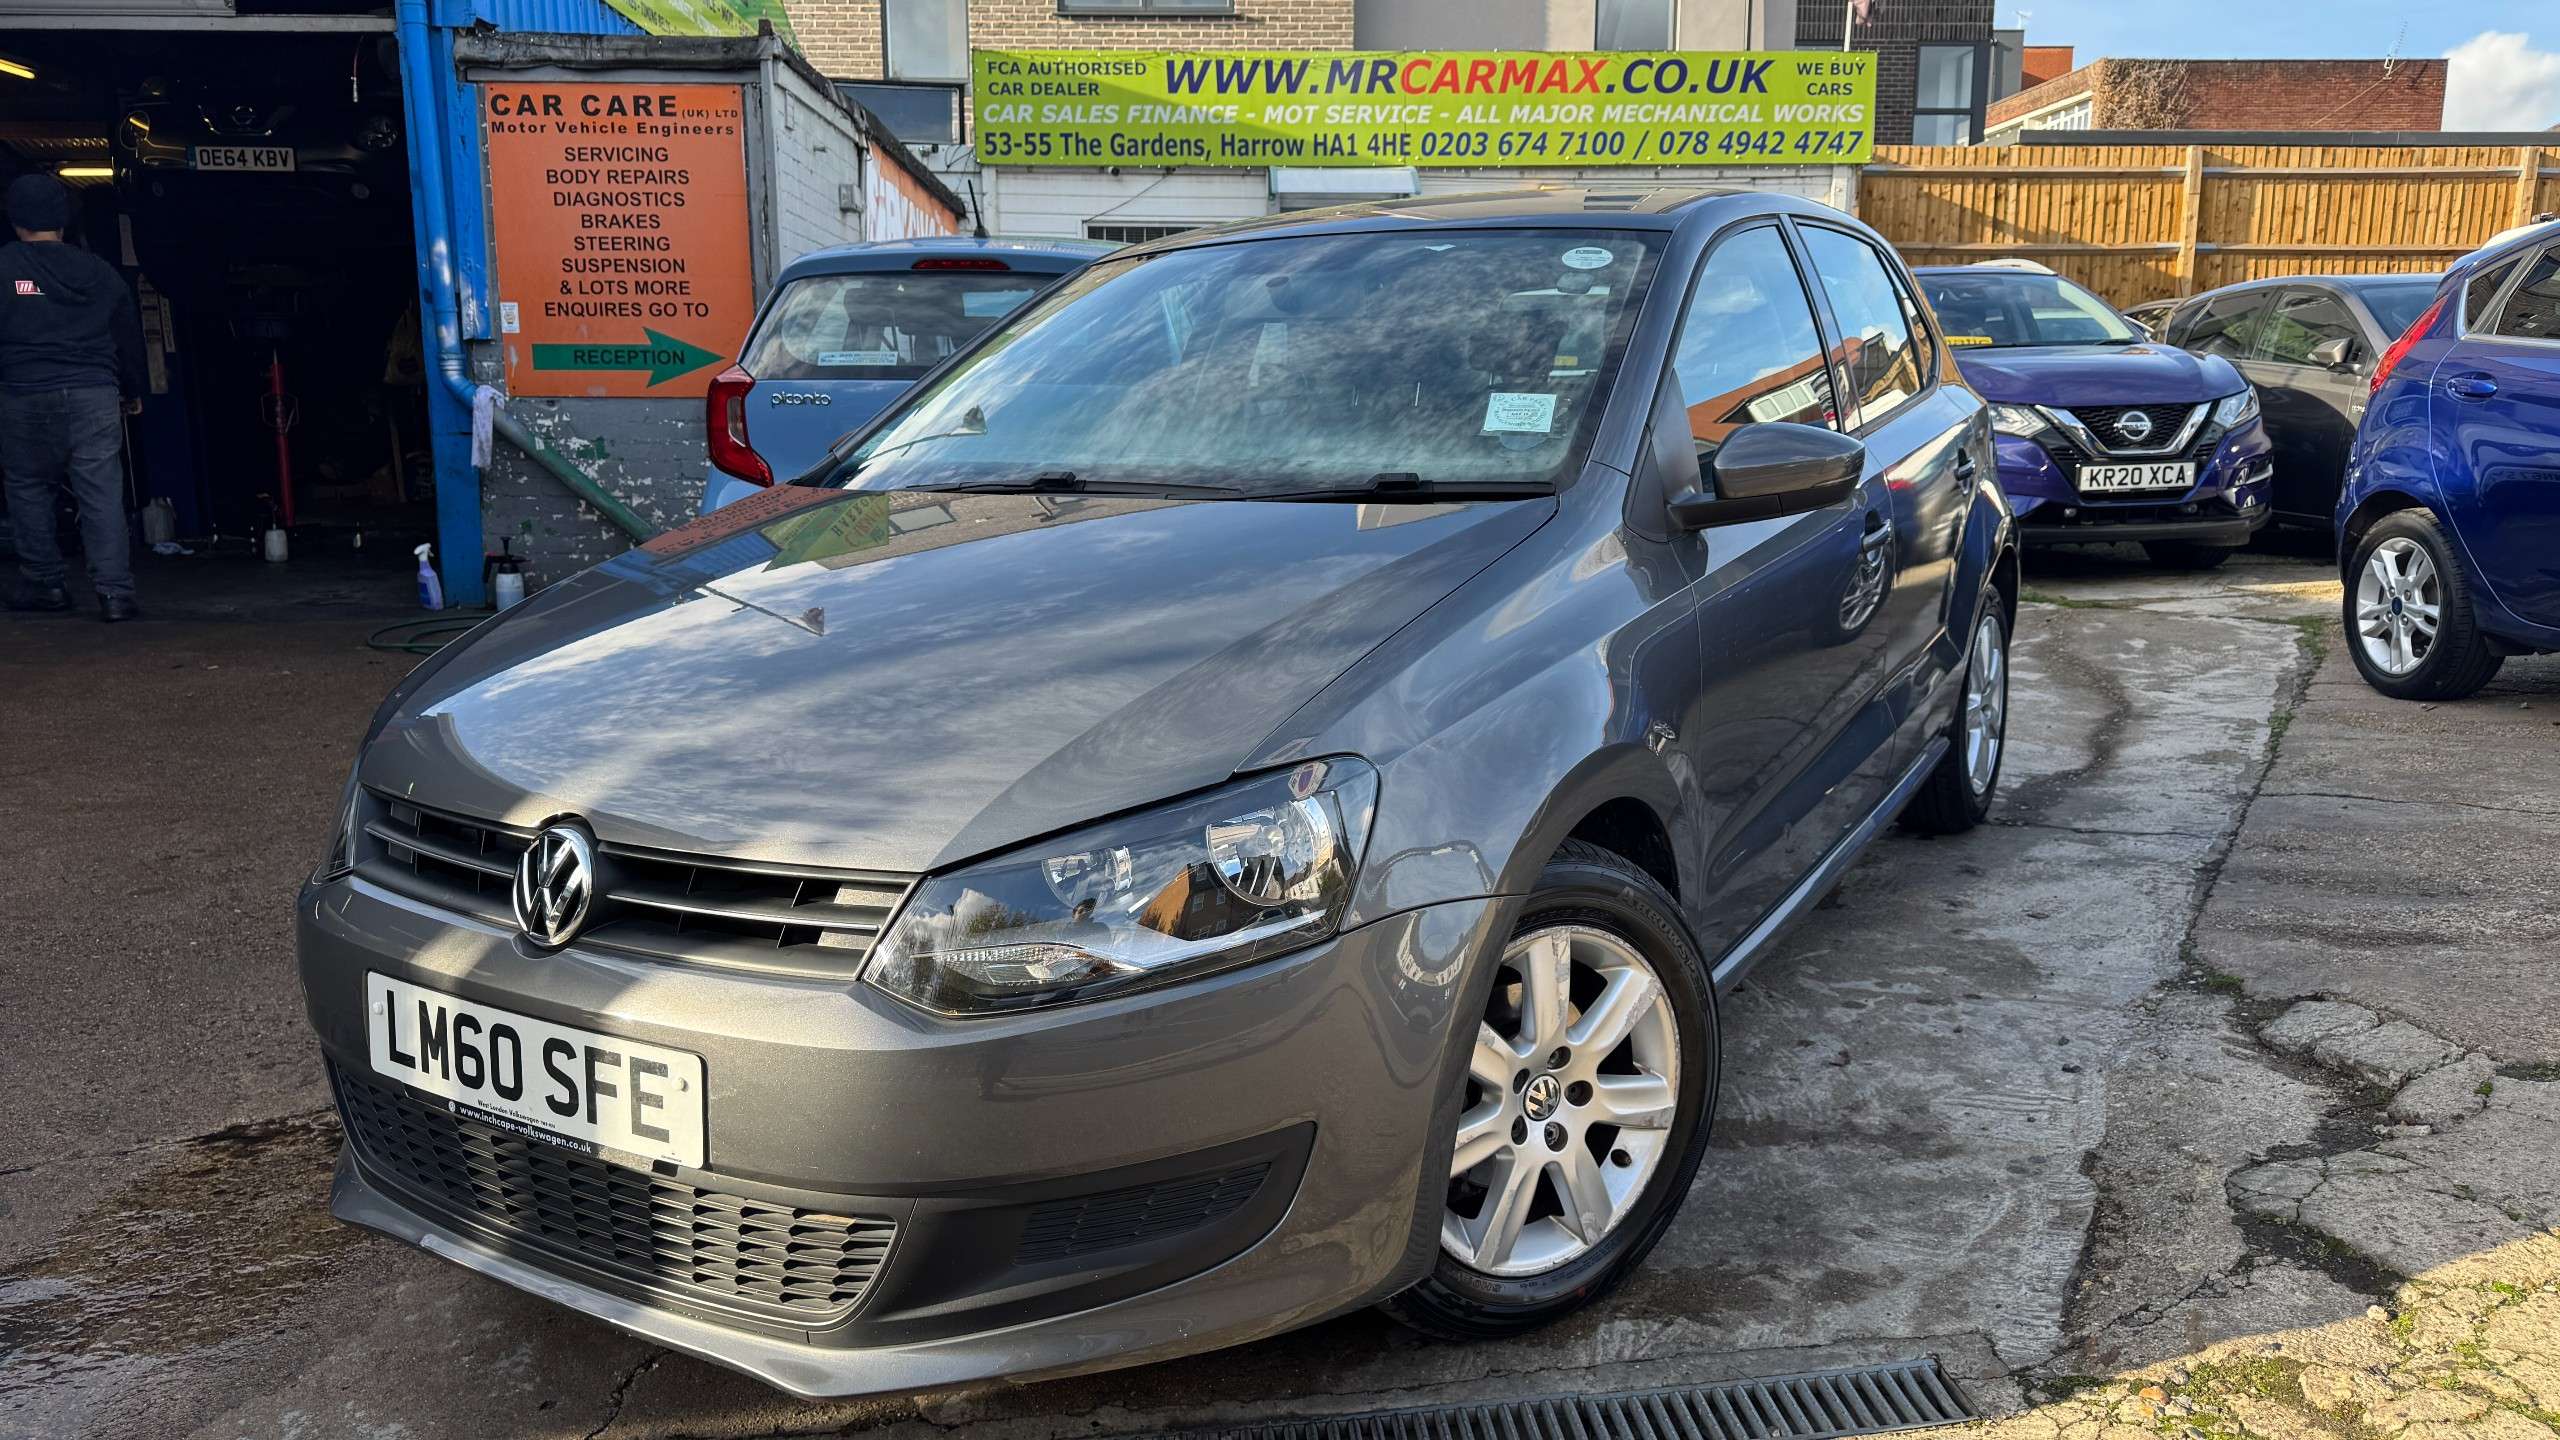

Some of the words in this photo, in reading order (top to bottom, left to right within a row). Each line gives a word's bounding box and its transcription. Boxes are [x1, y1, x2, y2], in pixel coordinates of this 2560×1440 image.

[988, 61, 1022, 76] FCA
[1027, 61, 1147, 76] AUTHORISED
[1165, 58, 1775, 95] WWW.MRCARMAX.CO.UK
[1796, 62, 1826, 76] WE
[1830, 62, 1866, 76] BUY
[988, 82, 1026, 96] CAR
[1030, 82, 1100, 96] DEALER
[1806, 82, 1854, 96] CARS
[490, 94, 563, 116] CAR
[581, 95, 677, 117] CARE
[681, 109, 710, 120] (UK)
[715, 110, 738, 118] LTD
[983, 103, 1037, 124] CAR
[1041, 104, 1121, 124] SALES
[1126, 104, 1238, 124] FINANCE
[1263, 104, 1315, 124] MOT
[1324, 104, 1431, 124] SERVICE
[1456, 104, 1501, 124] ALL
[1509, 104, 1594, 124] MAJOR
[1602, 104, 1764, 124] MECHANICAL
[1773, 104, 1865, 123] WORKS
[491, 121, 547, 134] Motor
[555, 121, 628, 134] Vehicle
[637, 122, 734, 137] Engineers
[564, 146, 669, 162] SERVICING
[984, 133, 1051, 156] 53-55
[1060, 133, 1101, 157] The
[1109, 132, 1211, 161] Gardens,
[1221, 133, 1305, 157] Harrow
[1313, 133, 1358, 157] HA1
[1367, 133, 1411, 157] 4HE
[1421, 132, 1488, 156] 0203
[1498, 131, 1548, 156] 674
[1558, 131, 1625, 156] 7100
[1632, 131, 1650, 158] /
[1659, 131, 1710, 155] 078
[1717, 131, 1785, 155] 4942
[1793, 131, 1864, 155] 4747
[199, 148, 248, 167] OE64
[252, 149, 289, 168] KBV
[546, 169, 600, 184] BODY
[607, 169, 690, 184] REPAIRS
[553, 191, 685, 207] DIAGNOSTICS
[580, 213, 661, 229] BRAKES
[573, 236, 671, 251] STEERING
[561, 258, 686, 273] SUSPENSION
[559, 280, 572, 295] &
[578, 280, 628, 295] LOTS
[634, 280, 691, 295] MORE
[544, 302, 642, 318] ENQUIRES
[648, 302, 678, 318] GO
[684, 302, 709, 318] TO
[573, 350, 686, 365] RECEPTION
[771, 391, 832, 408] picanto
[2089, 467, 2143, 487] KR20
[2148, 465, 2186, 485] XCA
[386, 989, 523, 1102] LM60
[542, 1037, 670, 1144] SFE
